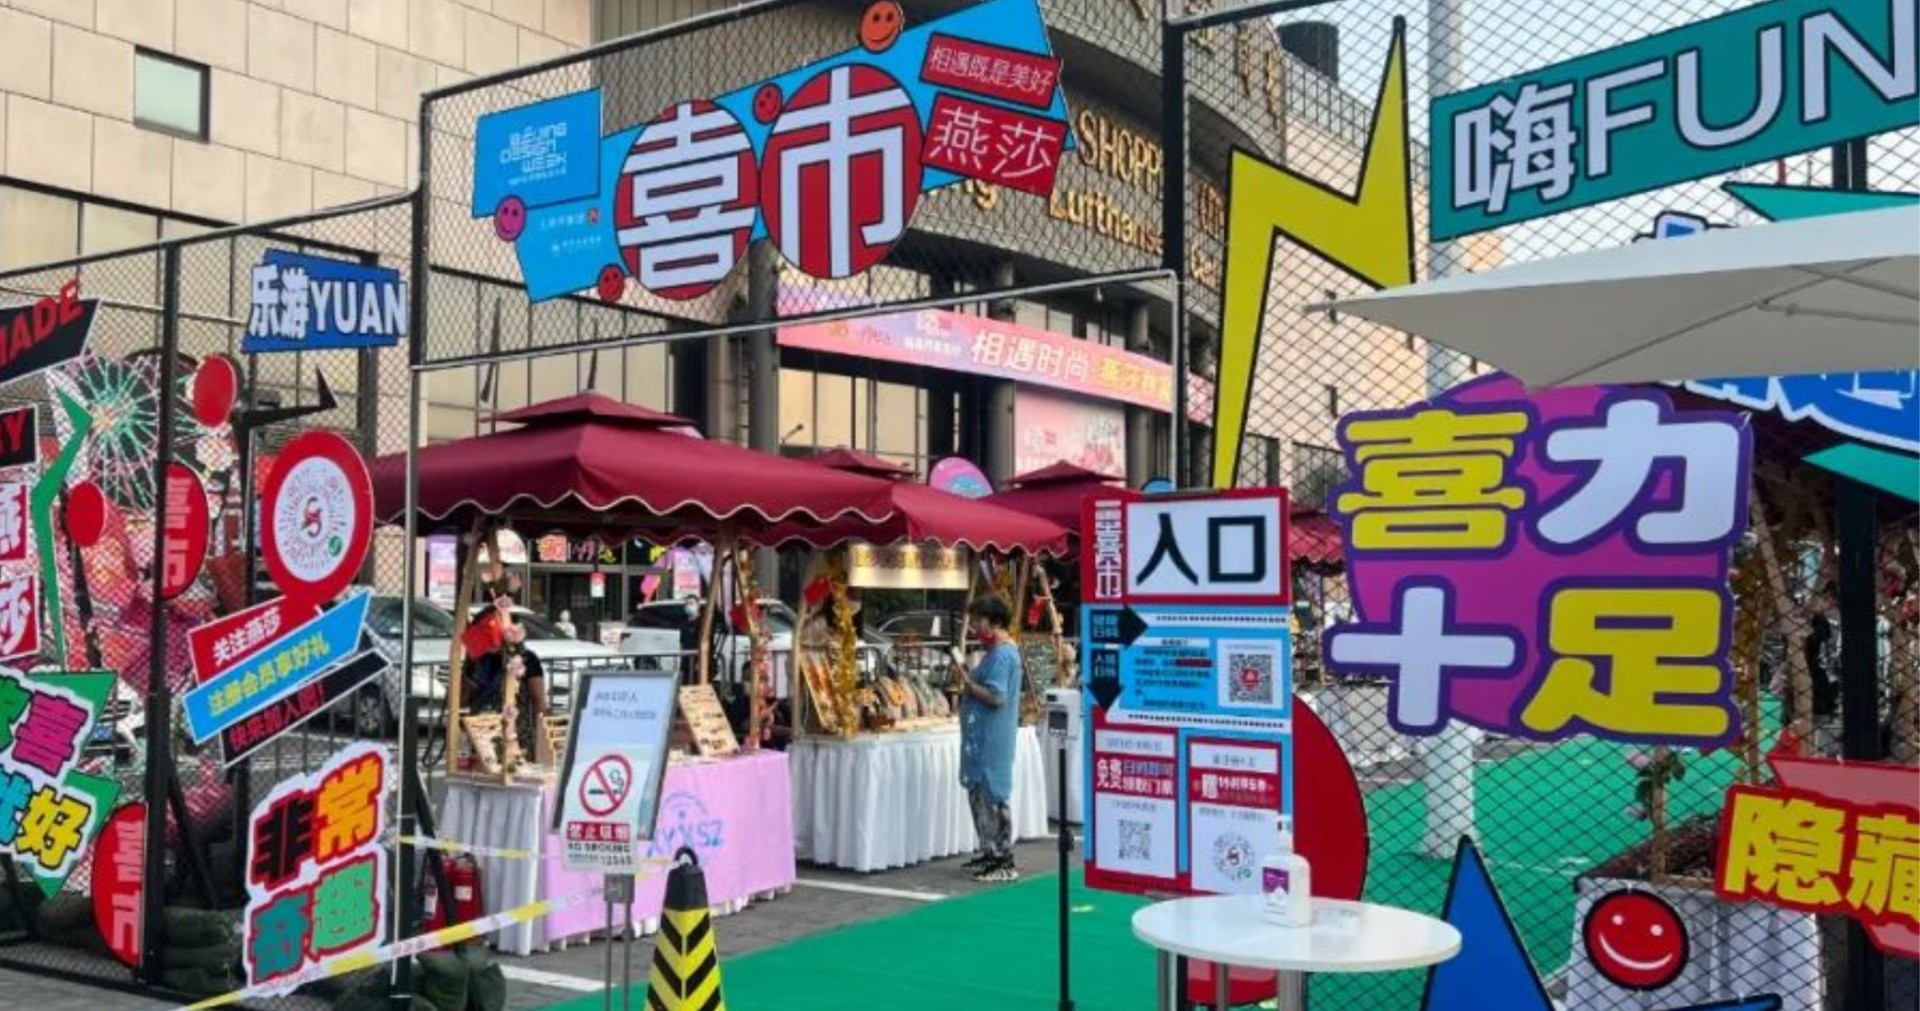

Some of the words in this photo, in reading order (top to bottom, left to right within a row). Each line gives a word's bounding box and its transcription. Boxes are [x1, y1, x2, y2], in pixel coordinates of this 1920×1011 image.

[930, 47, 1054, 96] 相遇既是美好
[929, 105, 1052, 178] 燕莎
[249, 264, 408, 339] 乐游YUAN
[971, 330, 1090, 384] 相遇时尚
[1337, 399, 1742, 550] 喜力
[1136, 512, 1266, 586] 入口
[1330, 586, 1730, 736] 十足
